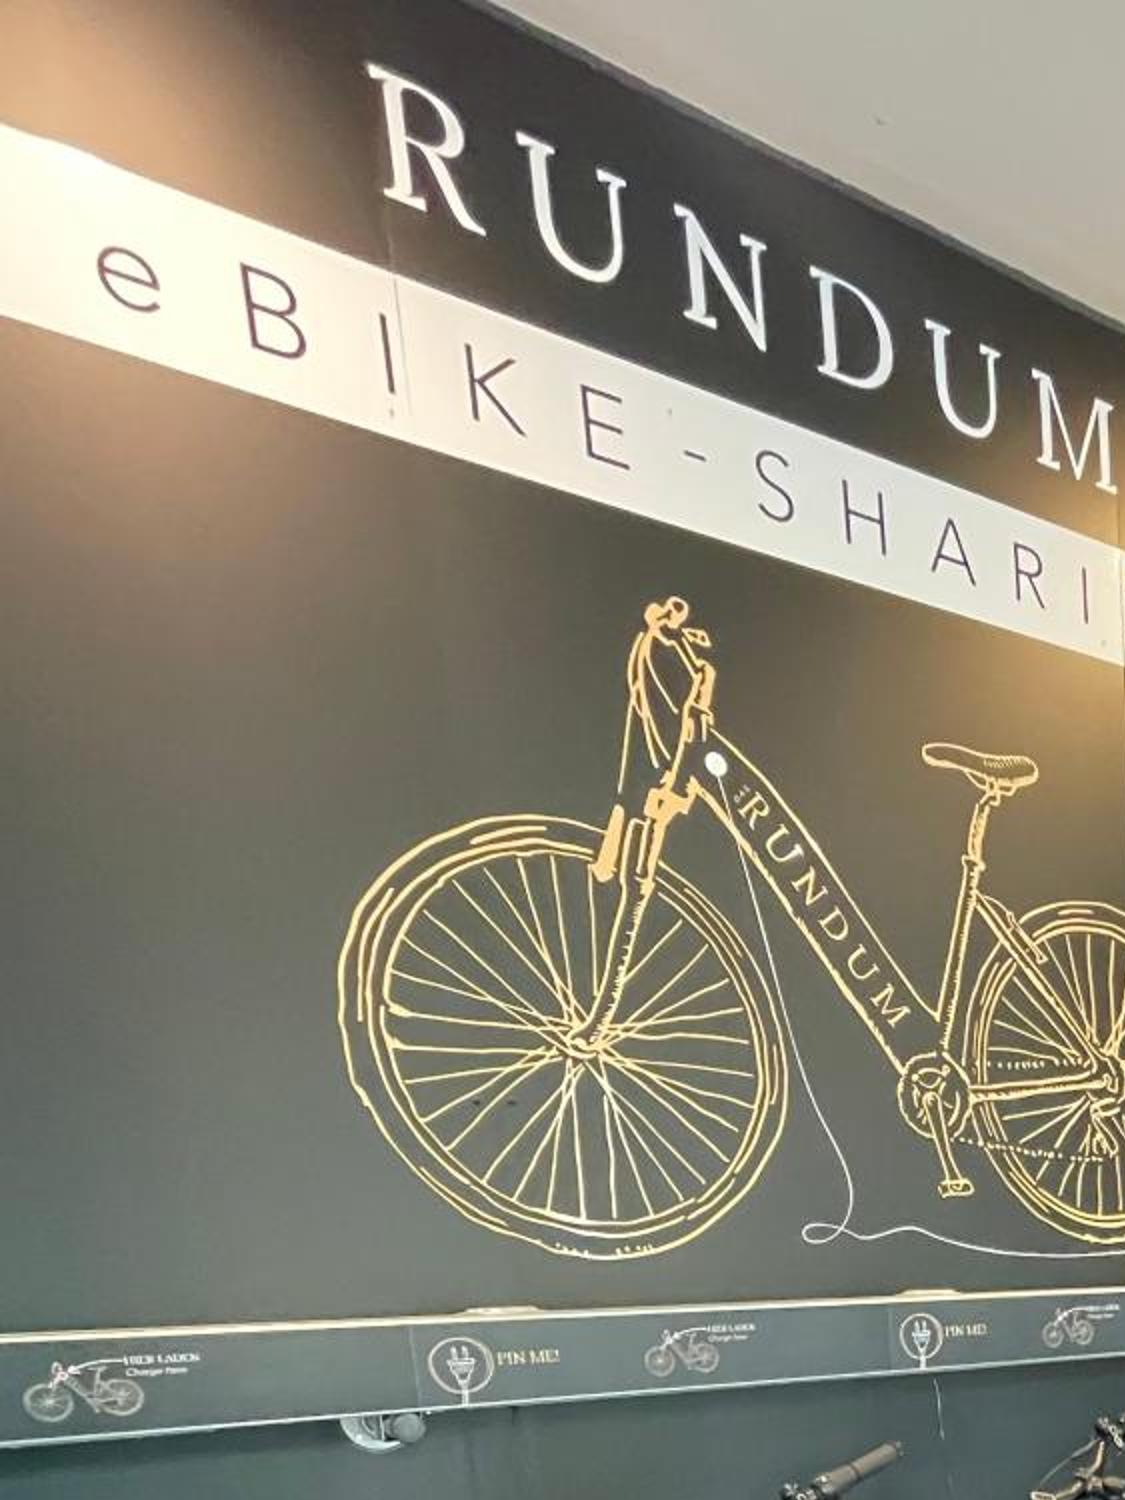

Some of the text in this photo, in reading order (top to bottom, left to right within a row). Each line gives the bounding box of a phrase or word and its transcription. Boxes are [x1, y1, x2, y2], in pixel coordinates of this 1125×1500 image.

[364, 61, 1118, 495] RUNDUM
[737, 791, 911, 1028] RUNDUM
[497, 1351, 526, 1366] PIN
